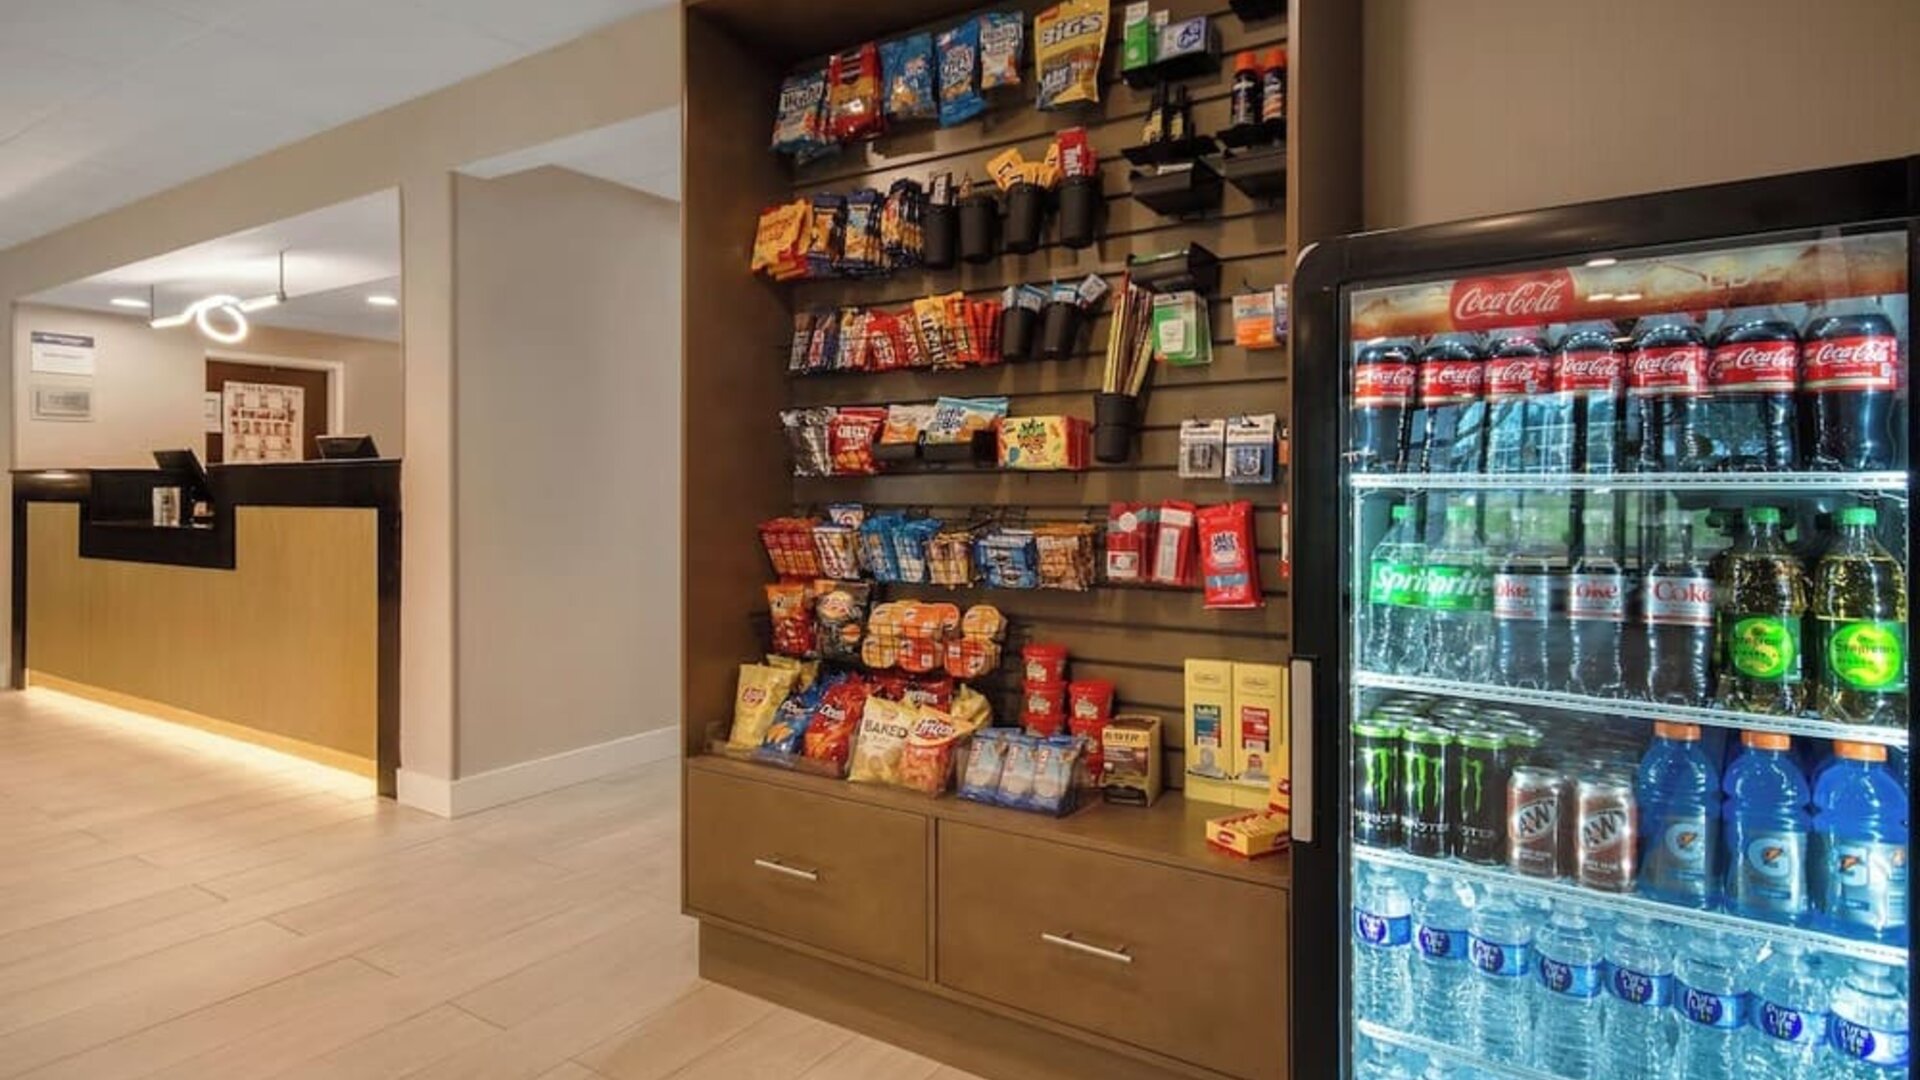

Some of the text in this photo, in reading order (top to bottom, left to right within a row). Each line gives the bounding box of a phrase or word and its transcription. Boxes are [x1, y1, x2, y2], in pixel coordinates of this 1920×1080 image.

[1455, 278, 1568, 320] Coca-Cola
[1815, 341, 1889, 365] Coca-Cola
[1562, 356, 1619, 376] Coca-Cola
[1654, 580, 1713, 603] Coke
[864, 719, 909, 739] BAKED
